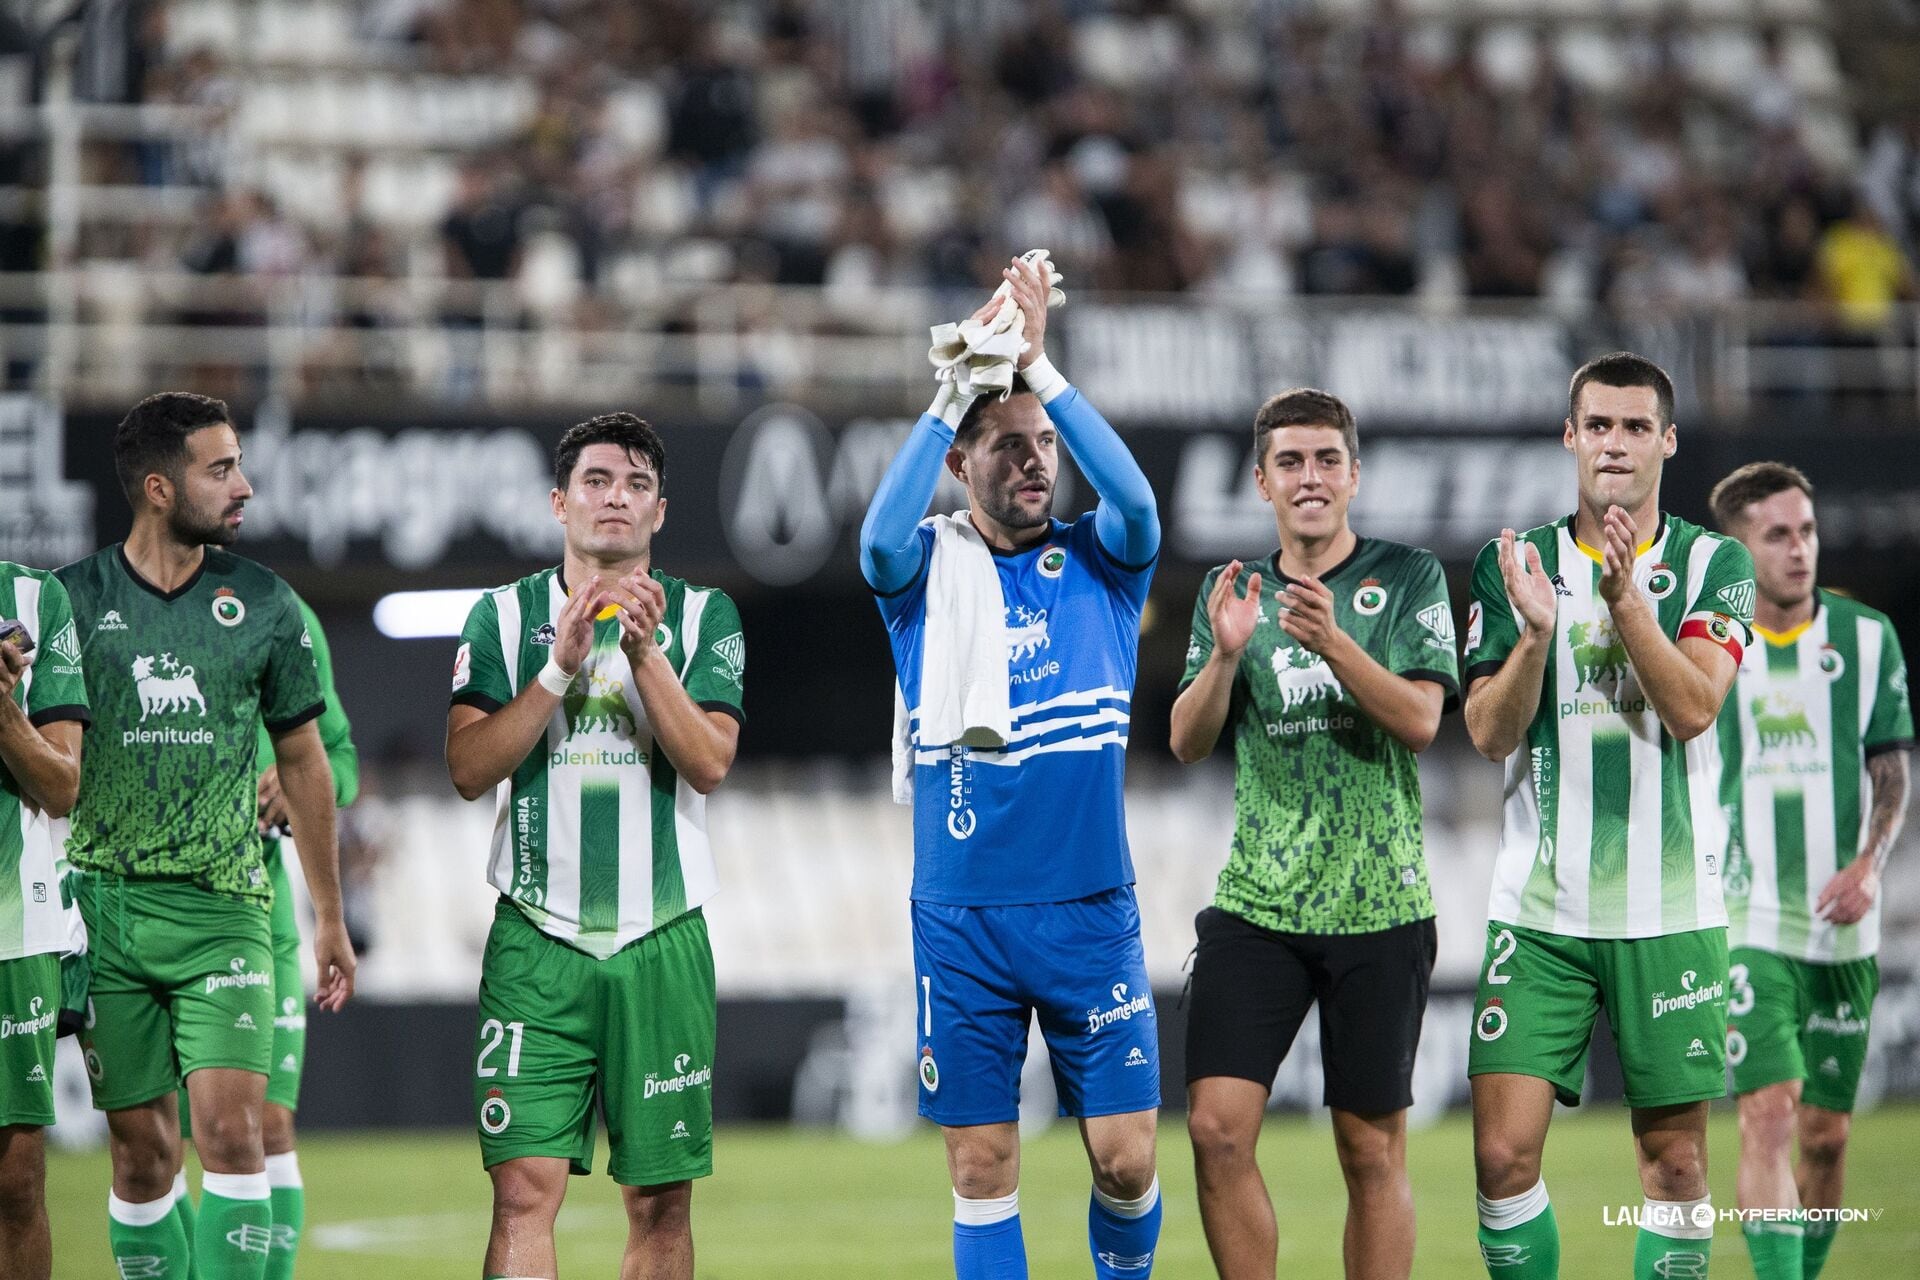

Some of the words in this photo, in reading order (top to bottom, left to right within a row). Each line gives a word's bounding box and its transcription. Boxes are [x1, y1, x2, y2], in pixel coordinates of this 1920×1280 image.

[123, 726, 214, 747] plenitude
[1267, 714, 1354, 738] plenitude
[551, 749, 649, 769] plenitude
[951, 745, 963, 809] CANTAB
[517, 796, 532, 885] CANTABRIA
[531, 797, 541, 884] TELECOM
[1487, 929, 1518, 985] 2
[922, 976, 932, 1037] 1
[1653, 980, 1723, 1019] Dromedario
[476, 1018, 524, 1078] 21
[643, 1064, 711, 1099] Dromedario
